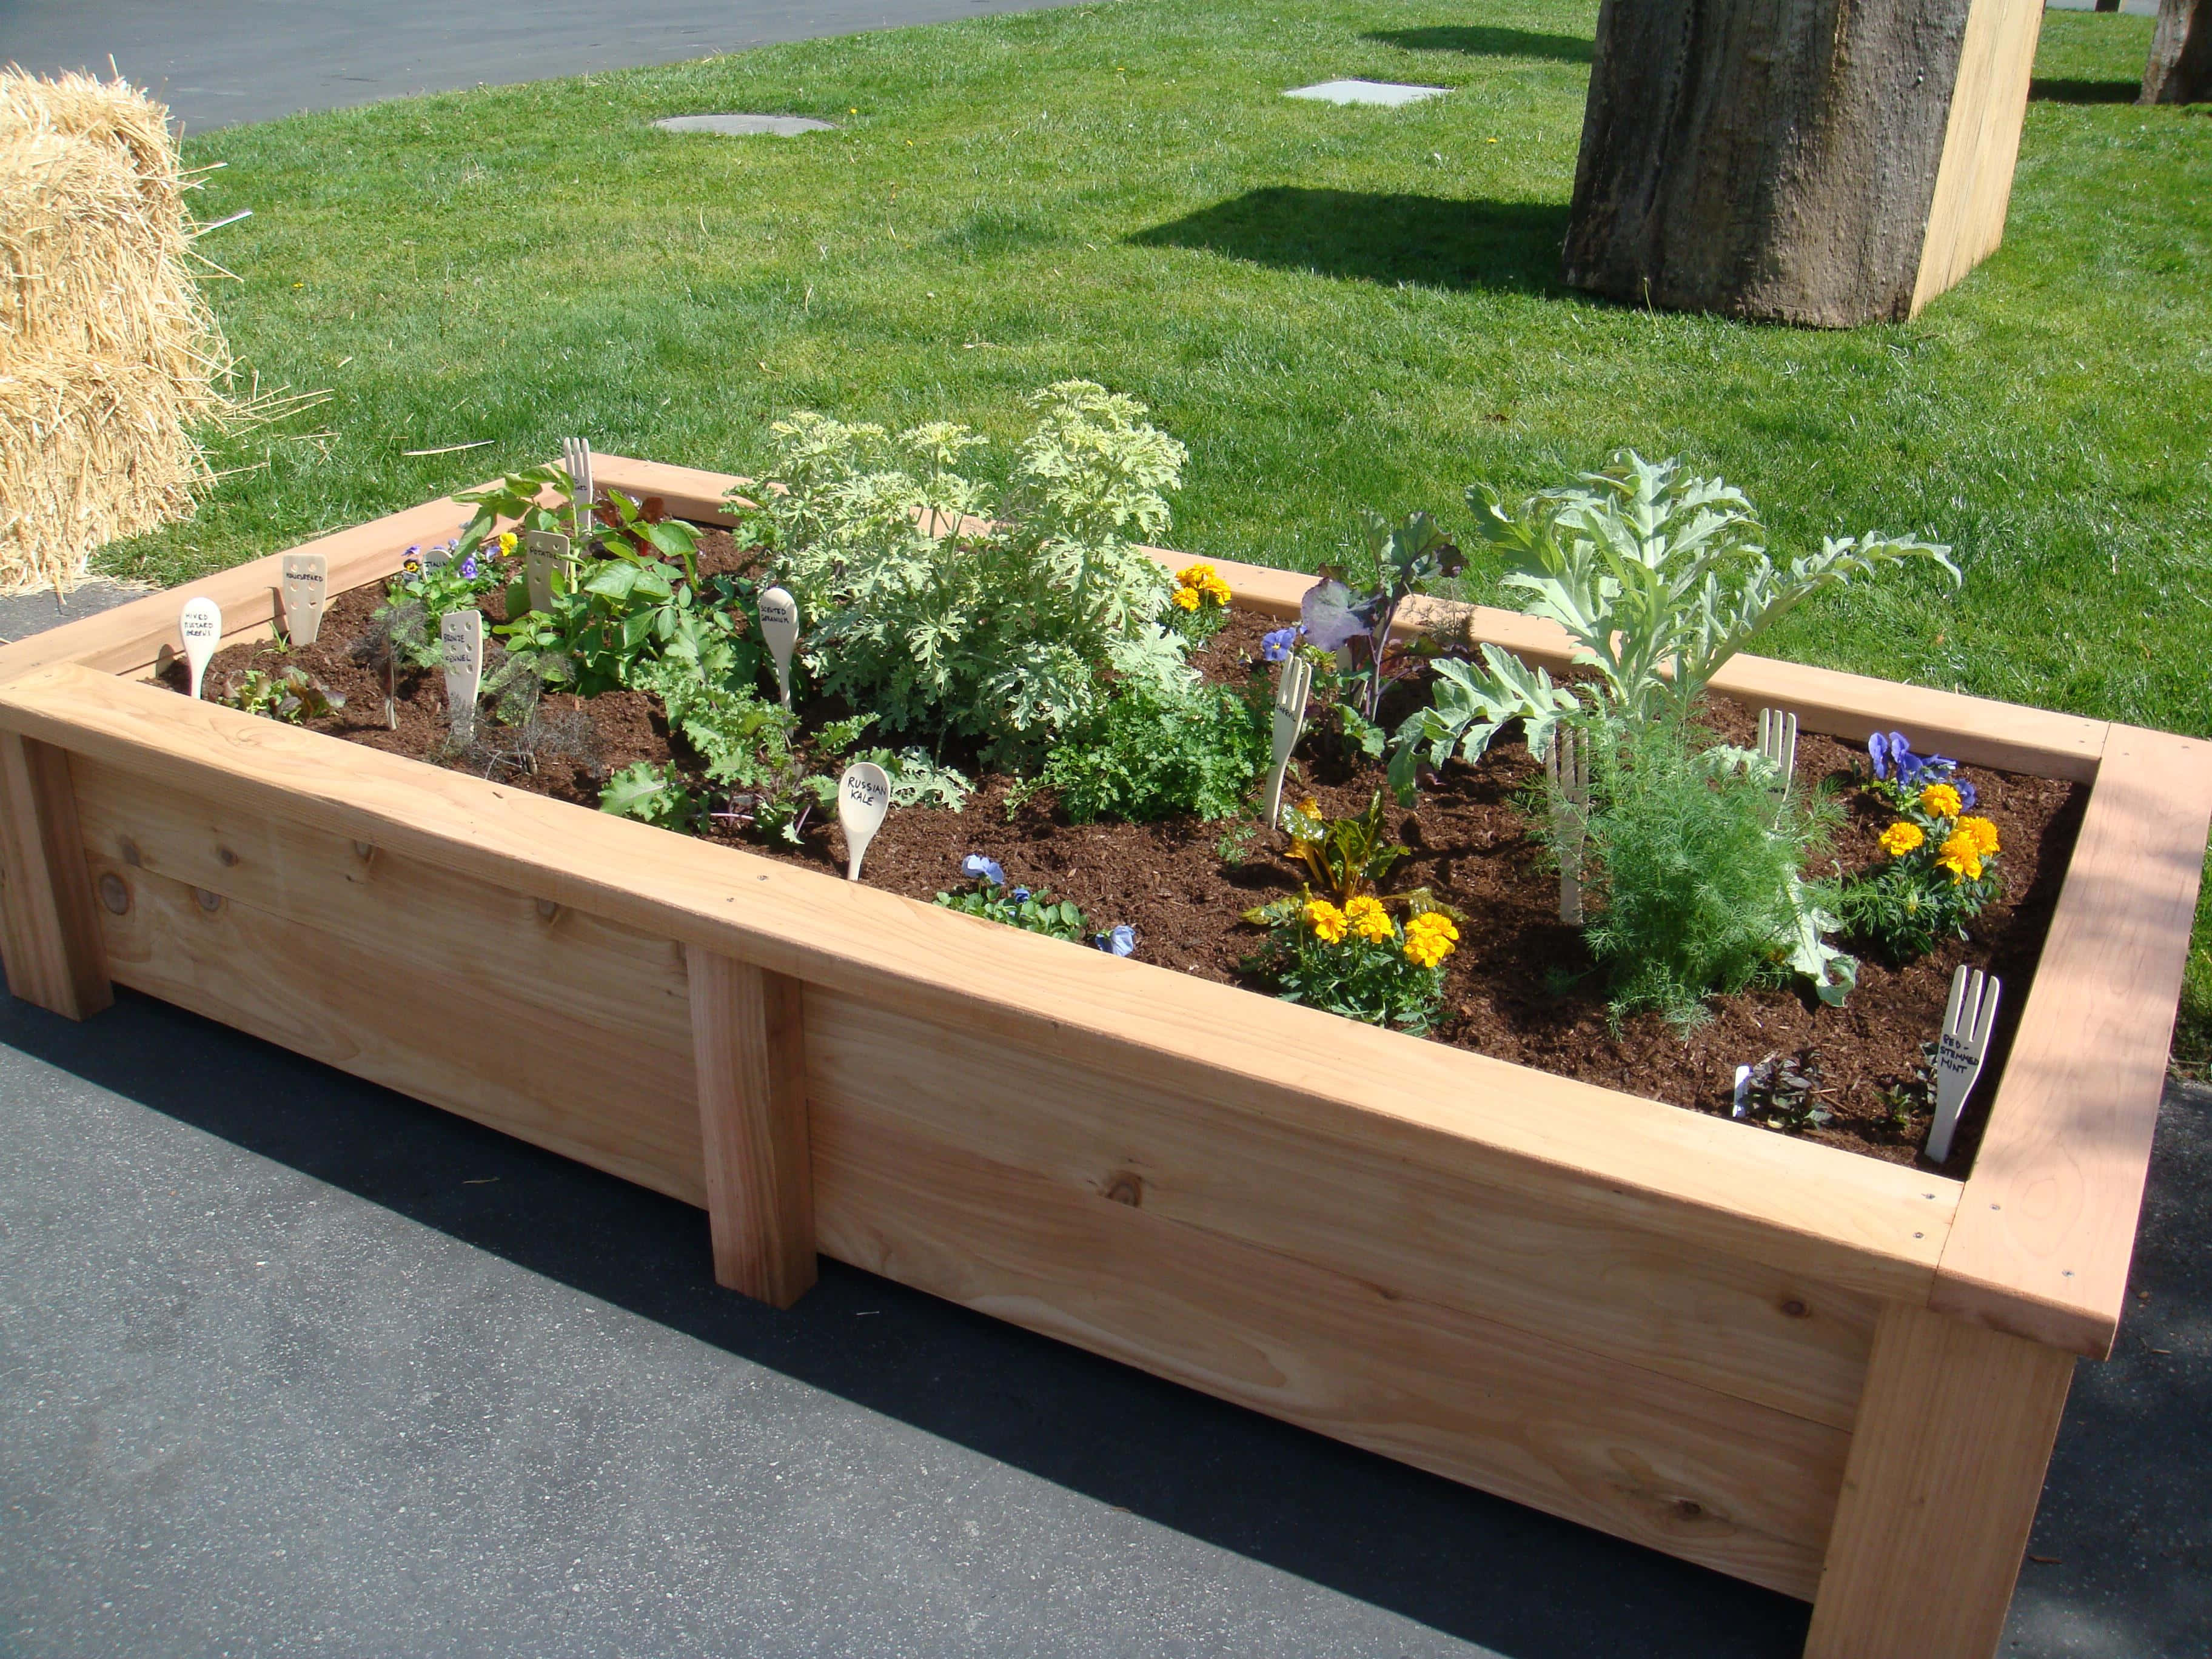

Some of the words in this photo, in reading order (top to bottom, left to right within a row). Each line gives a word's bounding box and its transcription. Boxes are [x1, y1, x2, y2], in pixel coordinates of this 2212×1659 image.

[848, 776, 886, 796] RUSSIAN
[851, 789, 874, 806] KALE
[1940, 1045, 1979, 1066] STEMMED
[1940, 1056, 1968, 1074] MINT
